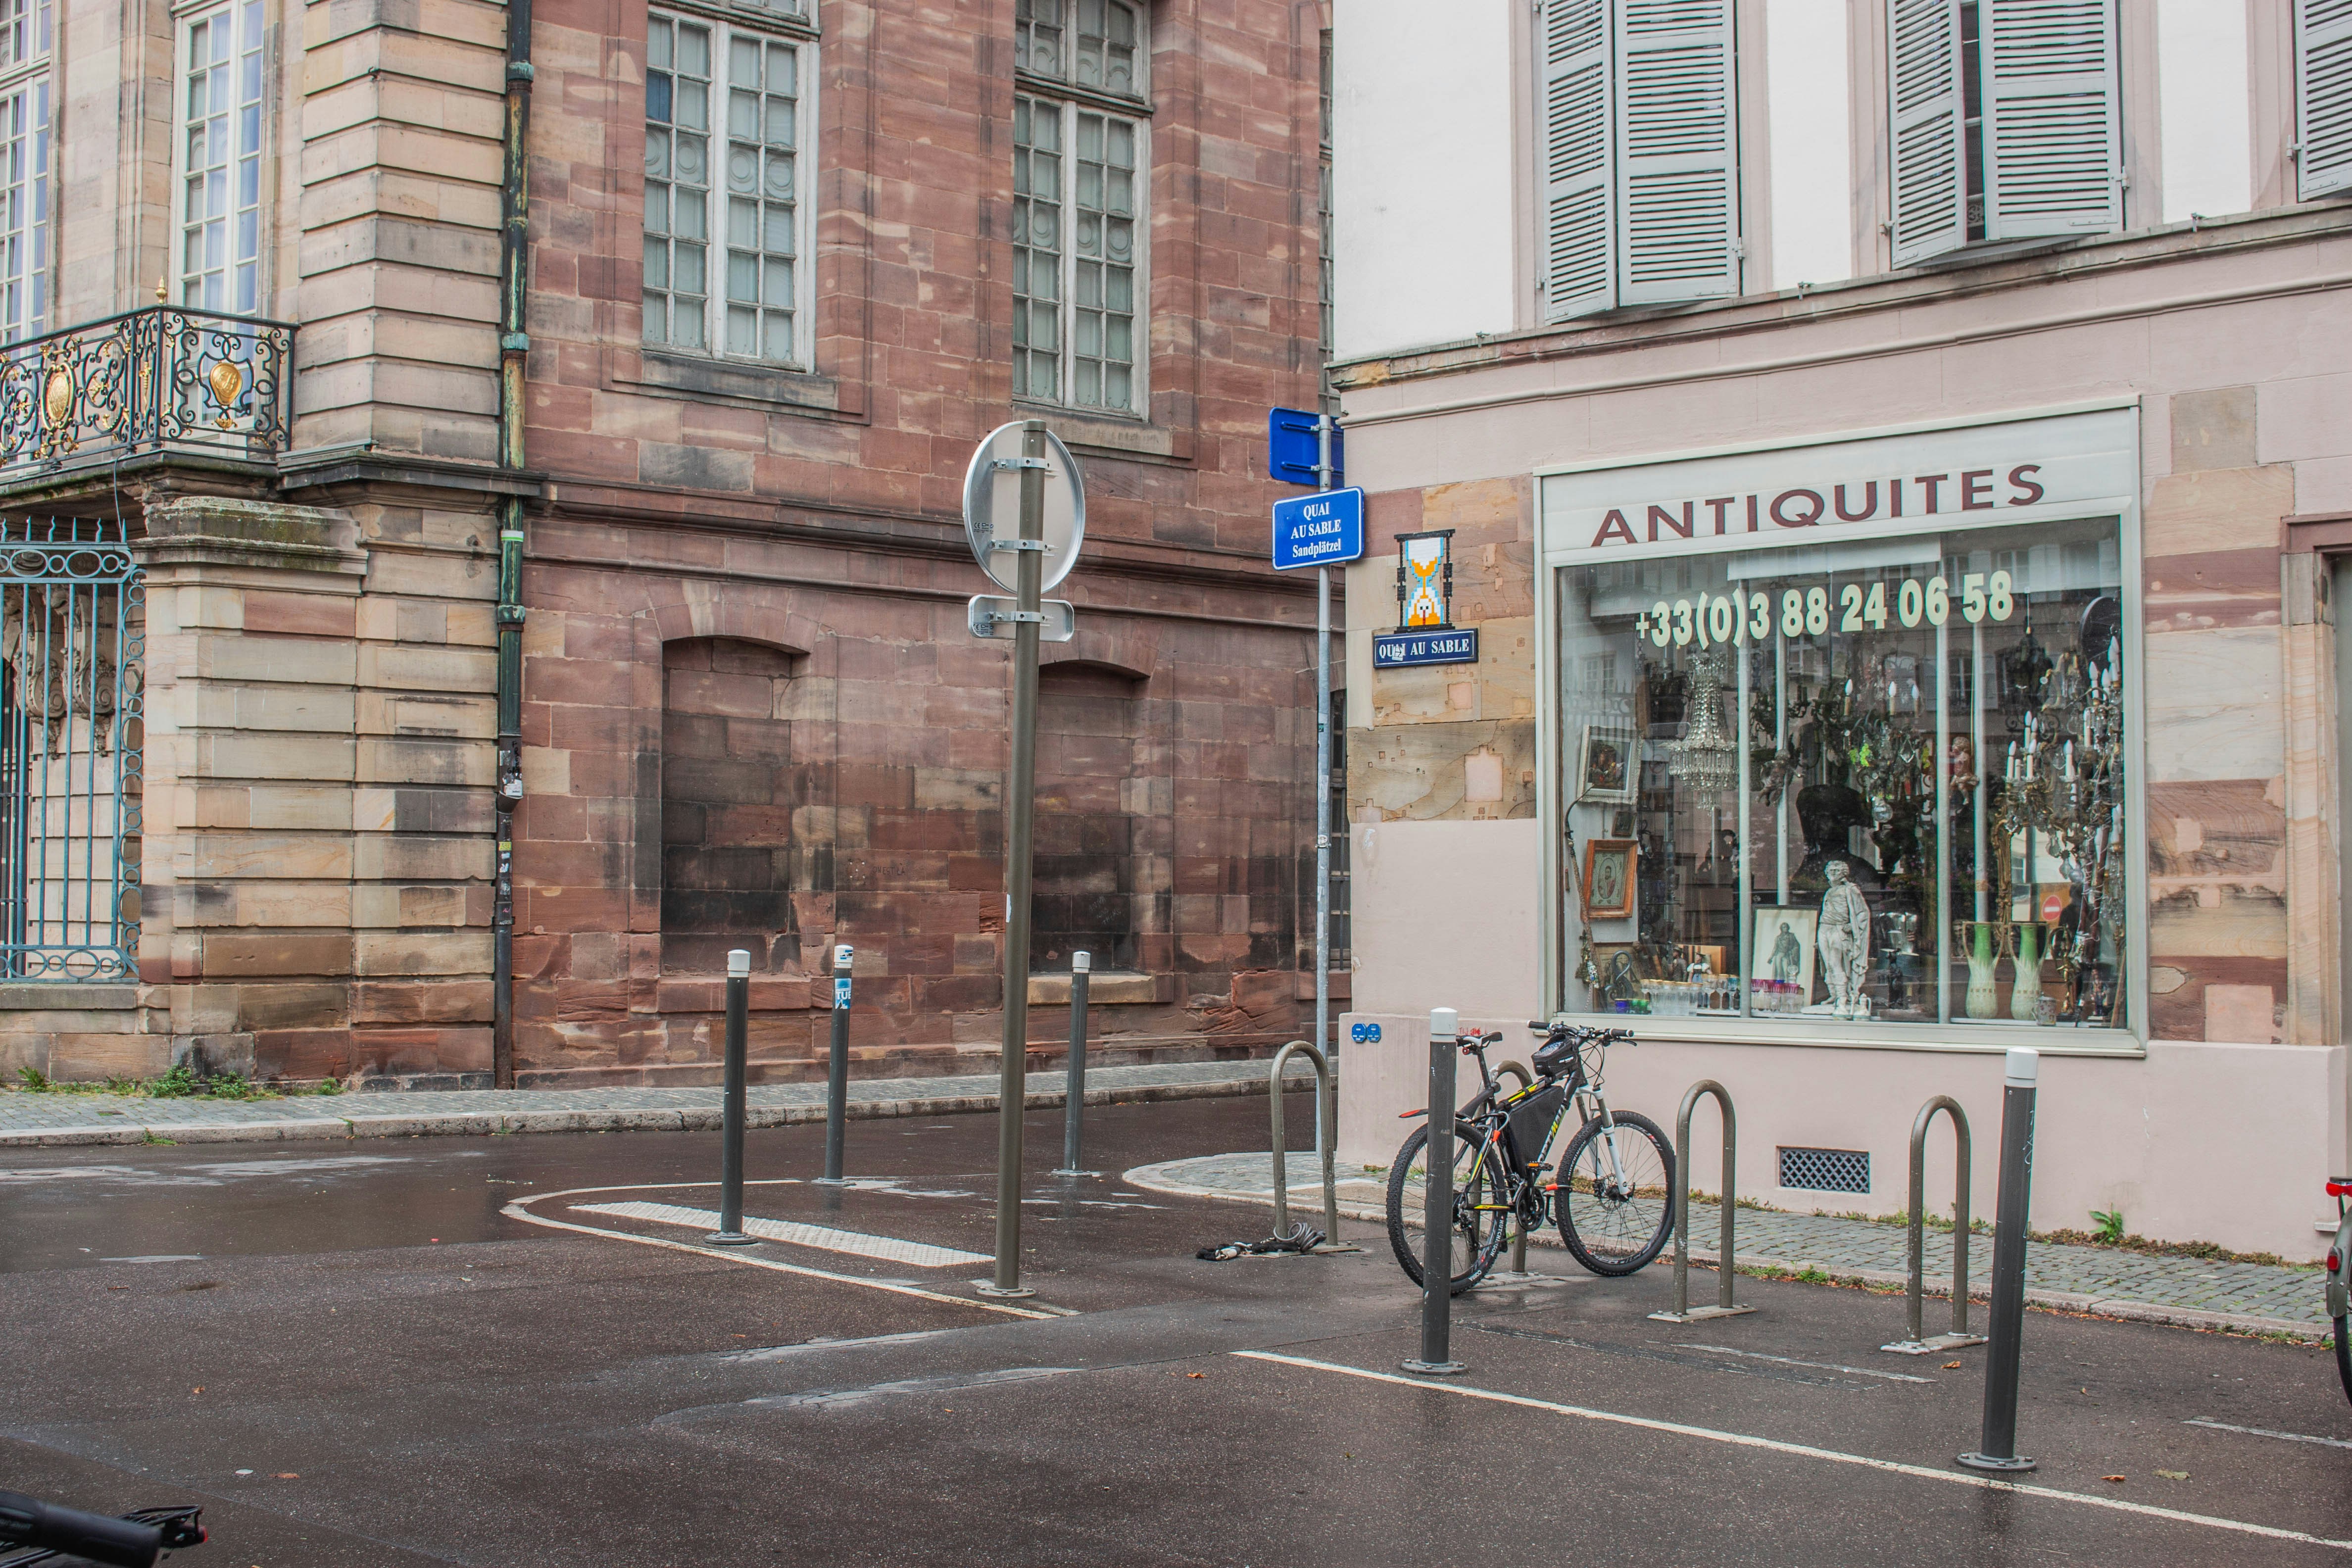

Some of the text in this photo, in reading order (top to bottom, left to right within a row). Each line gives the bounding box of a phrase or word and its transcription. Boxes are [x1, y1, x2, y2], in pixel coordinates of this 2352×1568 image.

[1303, 502, 1330, 521] QUAI
[1591, 464, 2044, 547] ANTIQUITES
[1290, 519, 1341, 539] AU SABLE
[1292, 538, 1341, 558] Sandplätzel
[1635, 570, 2014, 650] +33(0)3 88 24 06 58
[1379, 638, 1469, 659] QUI AU SABLE
